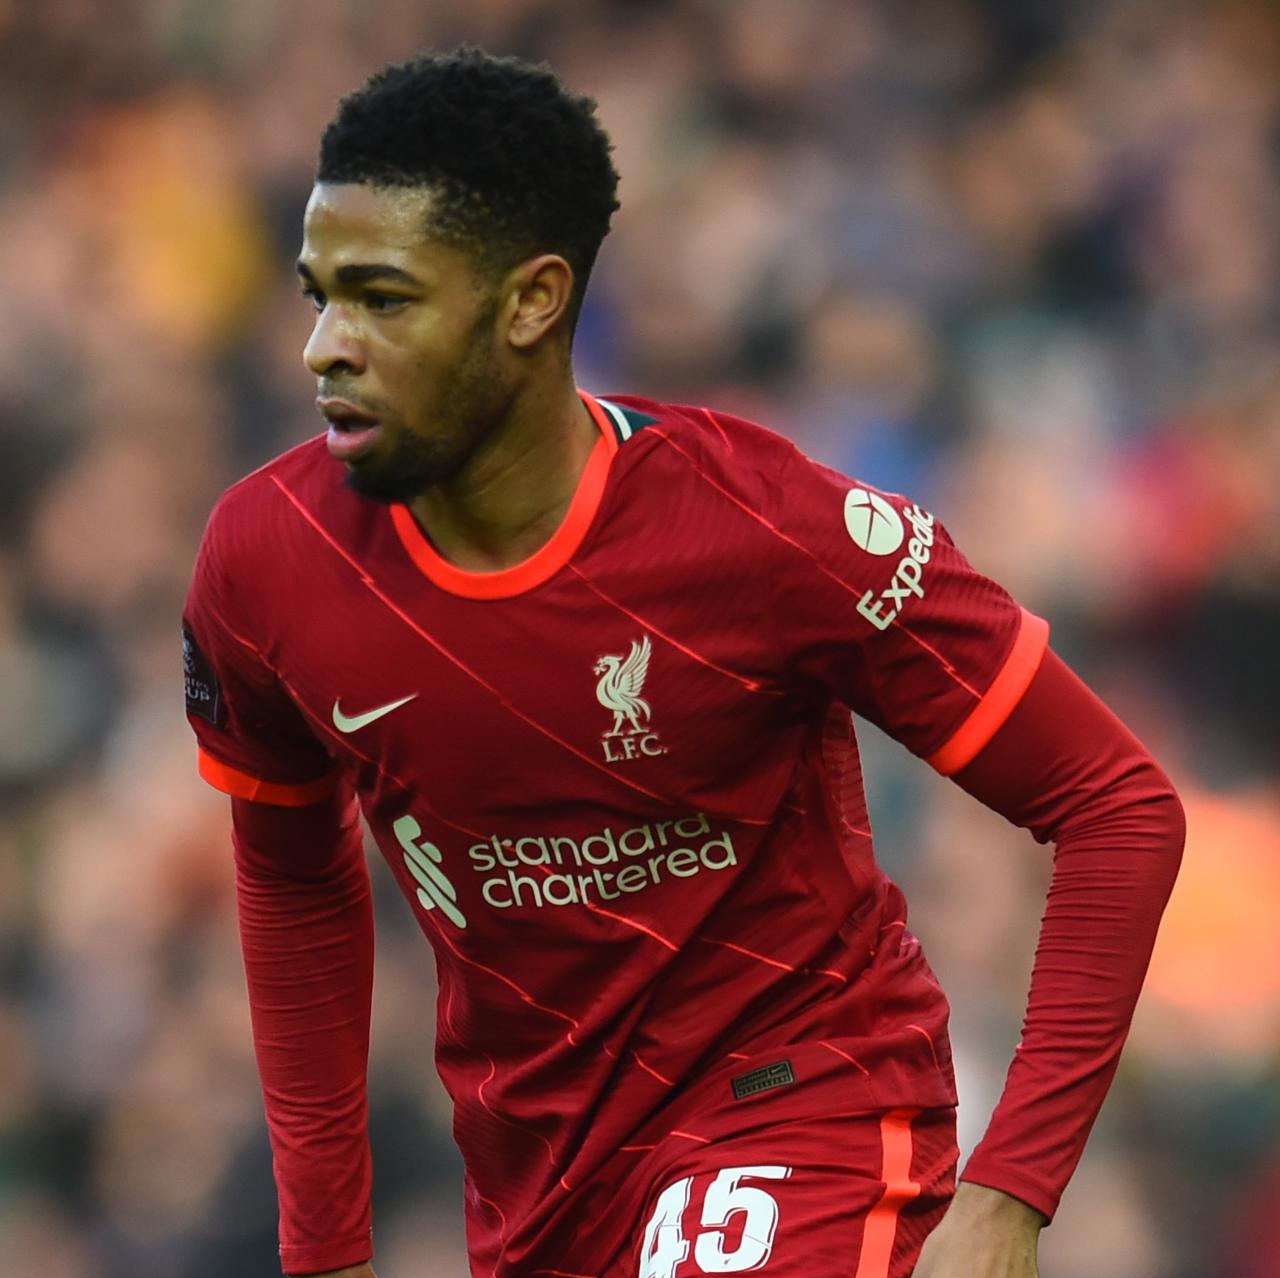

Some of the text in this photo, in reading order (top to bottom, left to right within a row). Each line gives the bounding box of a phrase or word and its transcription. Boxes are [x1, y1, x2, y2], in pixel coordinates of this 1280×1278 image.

[185, 685, 210, 701] UP
[468, 813, 711, 872] standard
[482, 832, 738, 909] chartered
